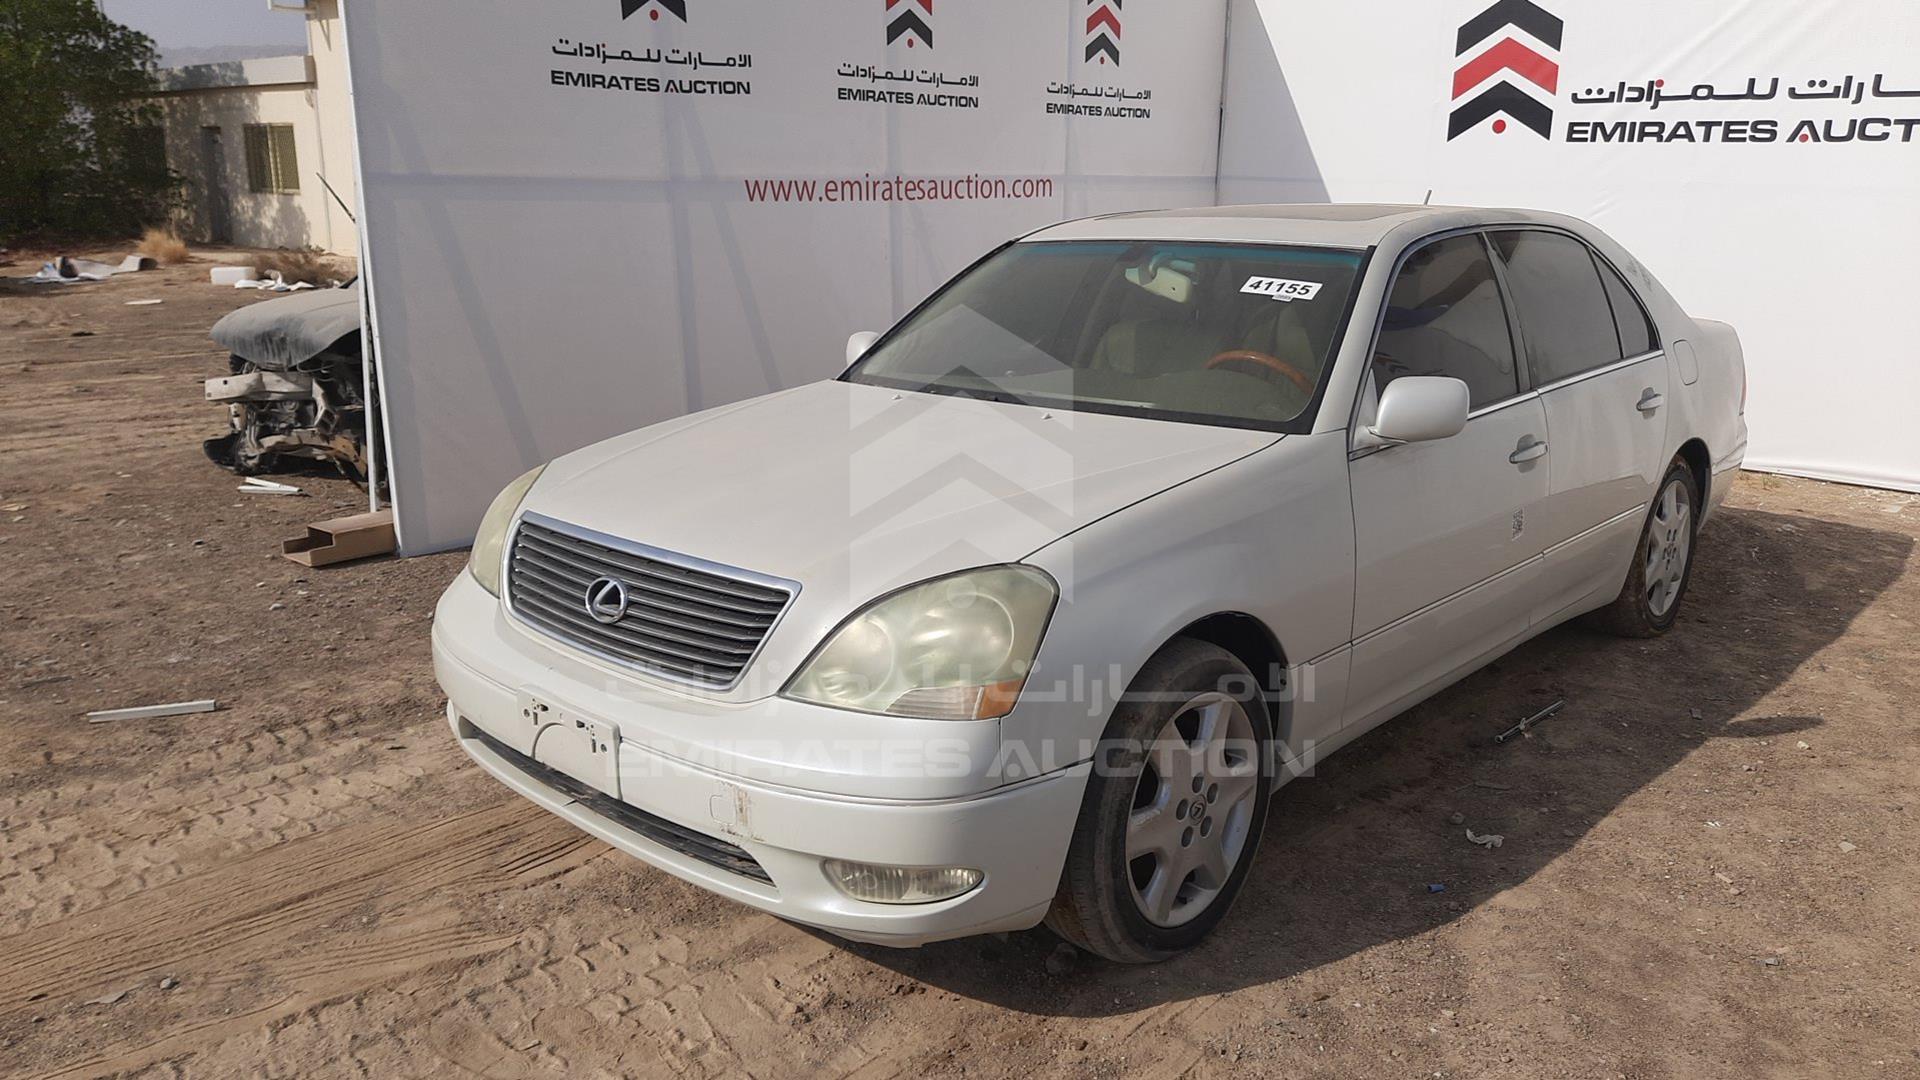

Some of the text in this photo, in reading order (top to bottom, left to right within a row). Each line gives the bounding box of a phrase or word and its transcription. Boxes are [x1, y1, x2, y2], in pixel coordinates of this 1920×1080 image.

[552, 38, 661, 64] للمزادات
[550, 69, 751, 94] EMIRATES AUCTION
[837, 62, 914, 83] للمزادات
[837, 87, 979, 108] EMIRATES AUCTION
[1571, 77, 1779, 110] للمزادات
[1046, 102, 1151, 119] EMIRATES AUCTION
[1565, 117, 1920, 143] EMIRATES AUCT
[744, 173, 1053, 203] www.emiratesauction.com
[1249, 279, 1313, 295] 41155
